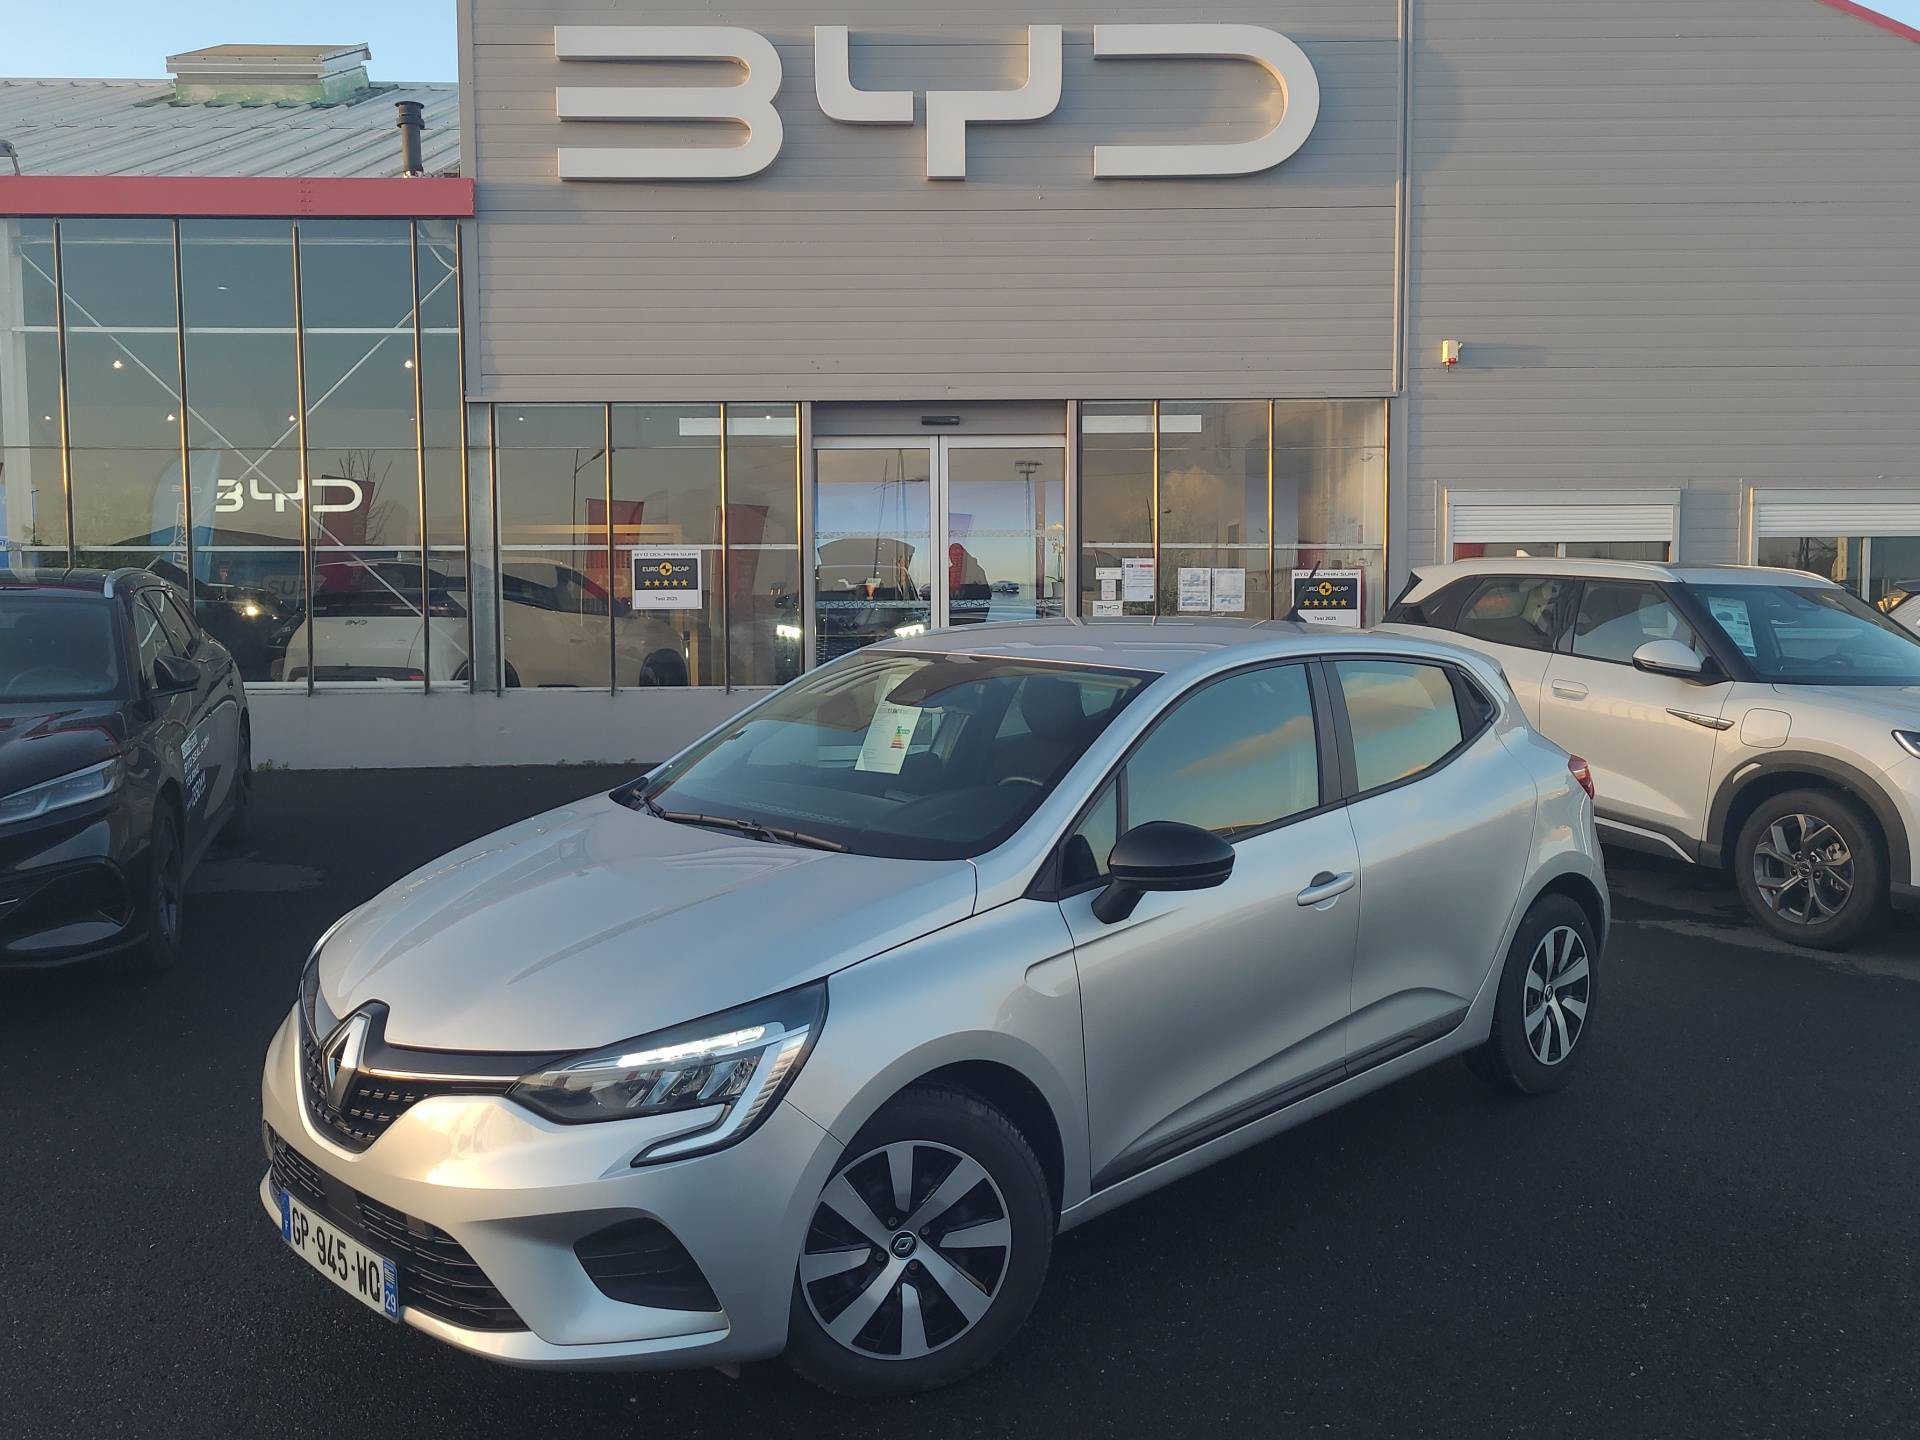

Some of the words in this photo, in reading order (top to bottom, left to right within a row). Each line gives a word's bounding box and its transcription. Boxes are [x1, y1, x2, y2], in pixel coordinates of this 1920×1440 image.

[554, 23, 1321, 181] BYD
[215, 479, 363, 513] BYD
[292, 1207, 381, 1303] GP-945-WQ
[385, 1291, 397, 1313] 29
